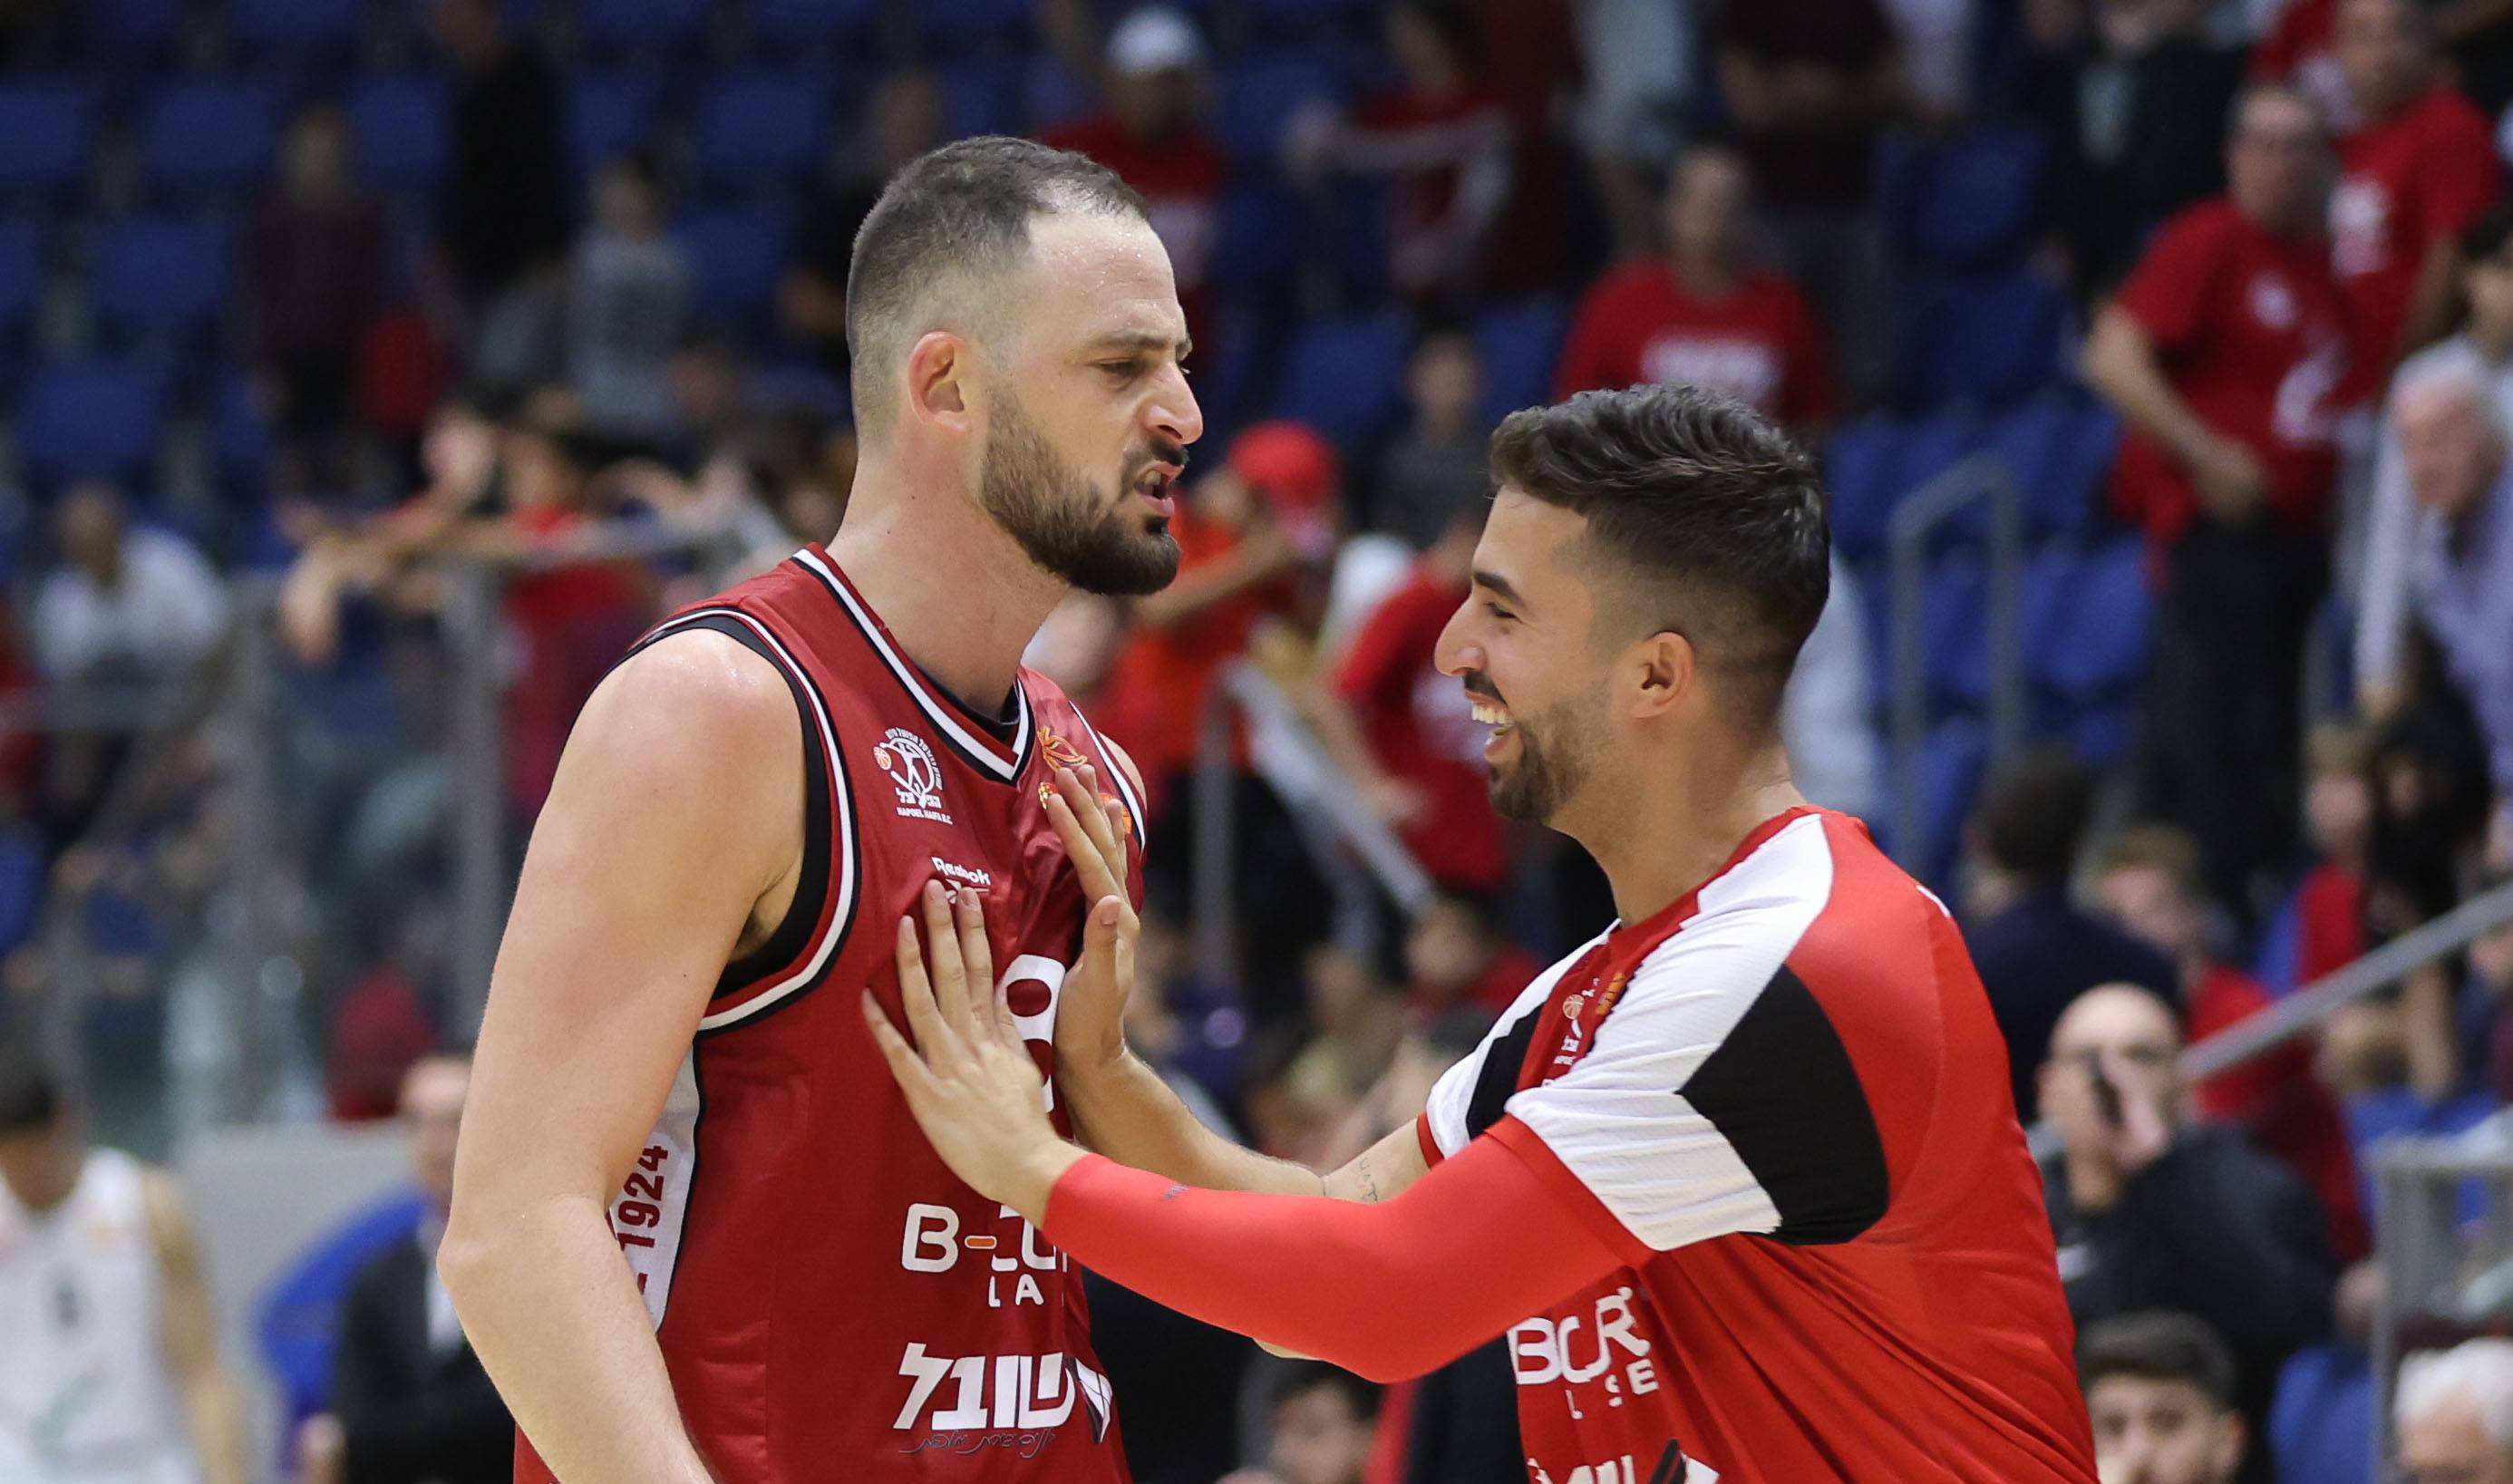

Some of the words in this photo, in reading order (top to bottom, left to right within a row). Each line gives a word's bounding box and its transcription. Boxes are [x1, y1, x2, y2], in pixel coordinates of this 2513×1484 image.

[931, 857, 991, 886] Reebok
[616, 1145, 668, 1252] 1924
[893, 1342, 1076, 1431] שובל
